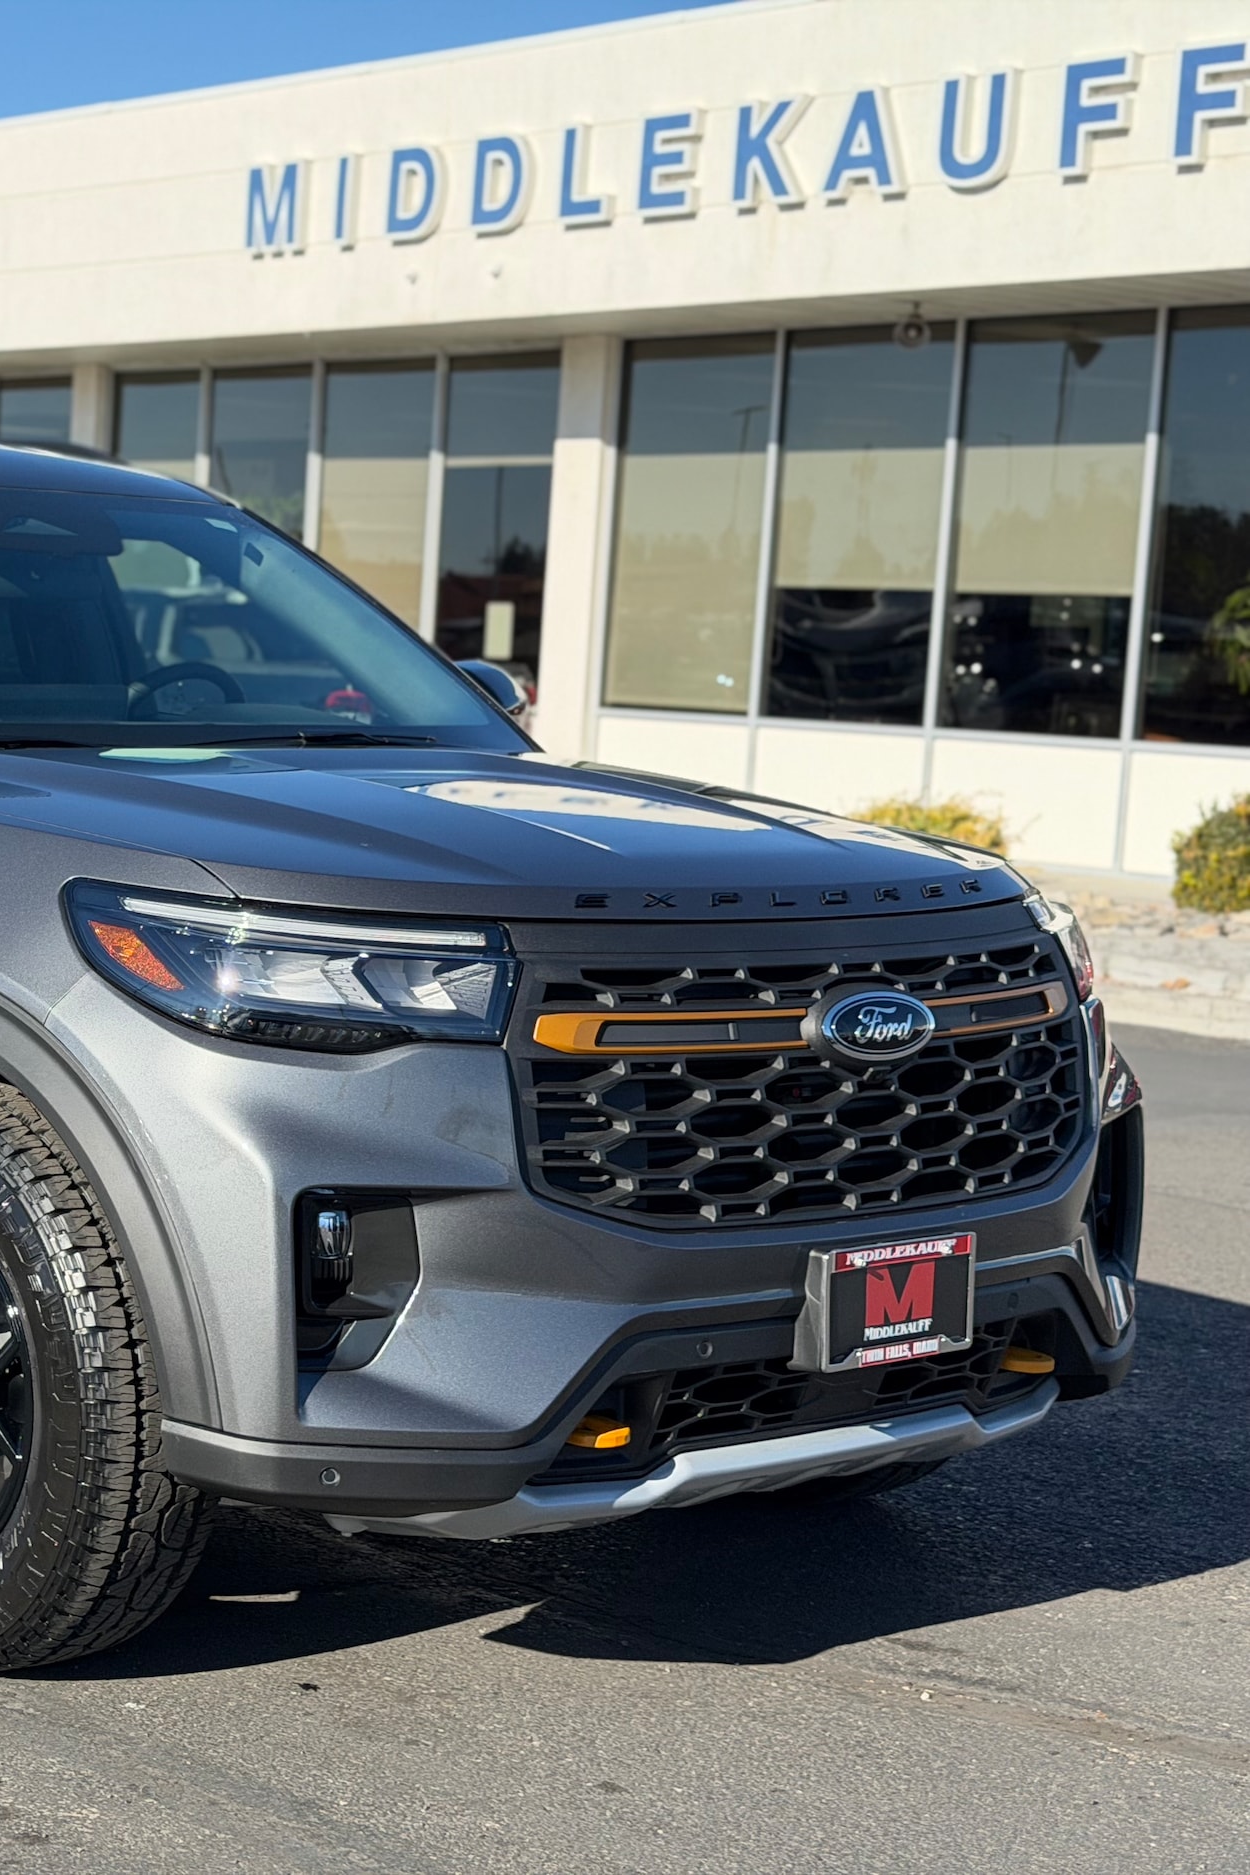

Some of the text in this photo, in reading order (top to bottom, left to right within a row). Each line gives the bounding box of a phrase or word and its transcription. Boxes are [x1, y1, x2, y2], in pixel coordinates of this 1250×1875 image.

[246, 41, 1250, 252] MIDDLEKAUFF
[573, 878, 983, 909] EXPLORER
[853, 1005, 913, 1045] Ford
[865, 1260, 936, 1328] M
[863, 1318, 934, 1342] MIDDLEKAUFF
[862, 1347, 885, 1364] TWIN
